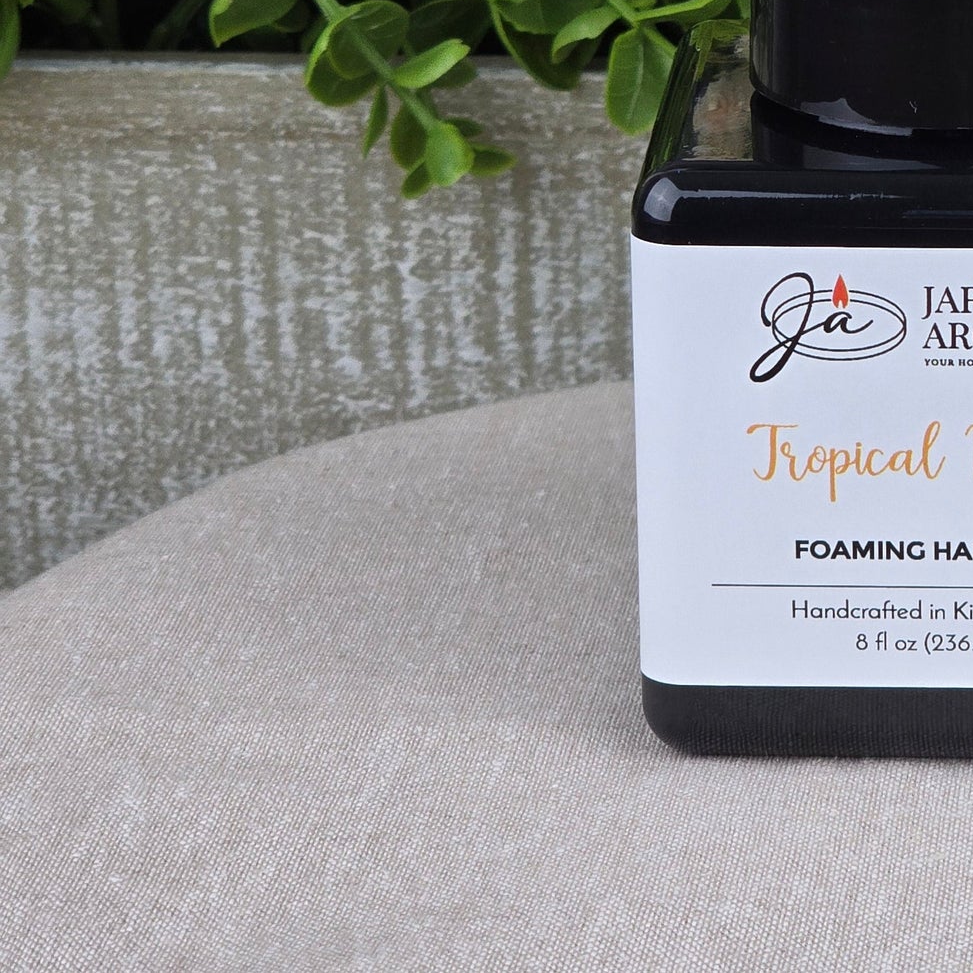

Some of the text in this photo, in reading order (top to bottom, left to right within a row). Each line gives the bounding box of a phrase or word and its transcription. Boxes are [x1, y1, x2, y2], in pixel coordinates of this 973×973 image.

[924, 358, 955, 367] YOUR
[746, 421, 946, 503] Tropical
[795, 539, 926, 561] FOAMING
[791, 599, 922, 621] Handcrafted
[929, 601, 946, 621] in
[855, 632, 869, 652] 8
[875, 630, 889, 652] fl
[894, 637, 918, 652] oz
